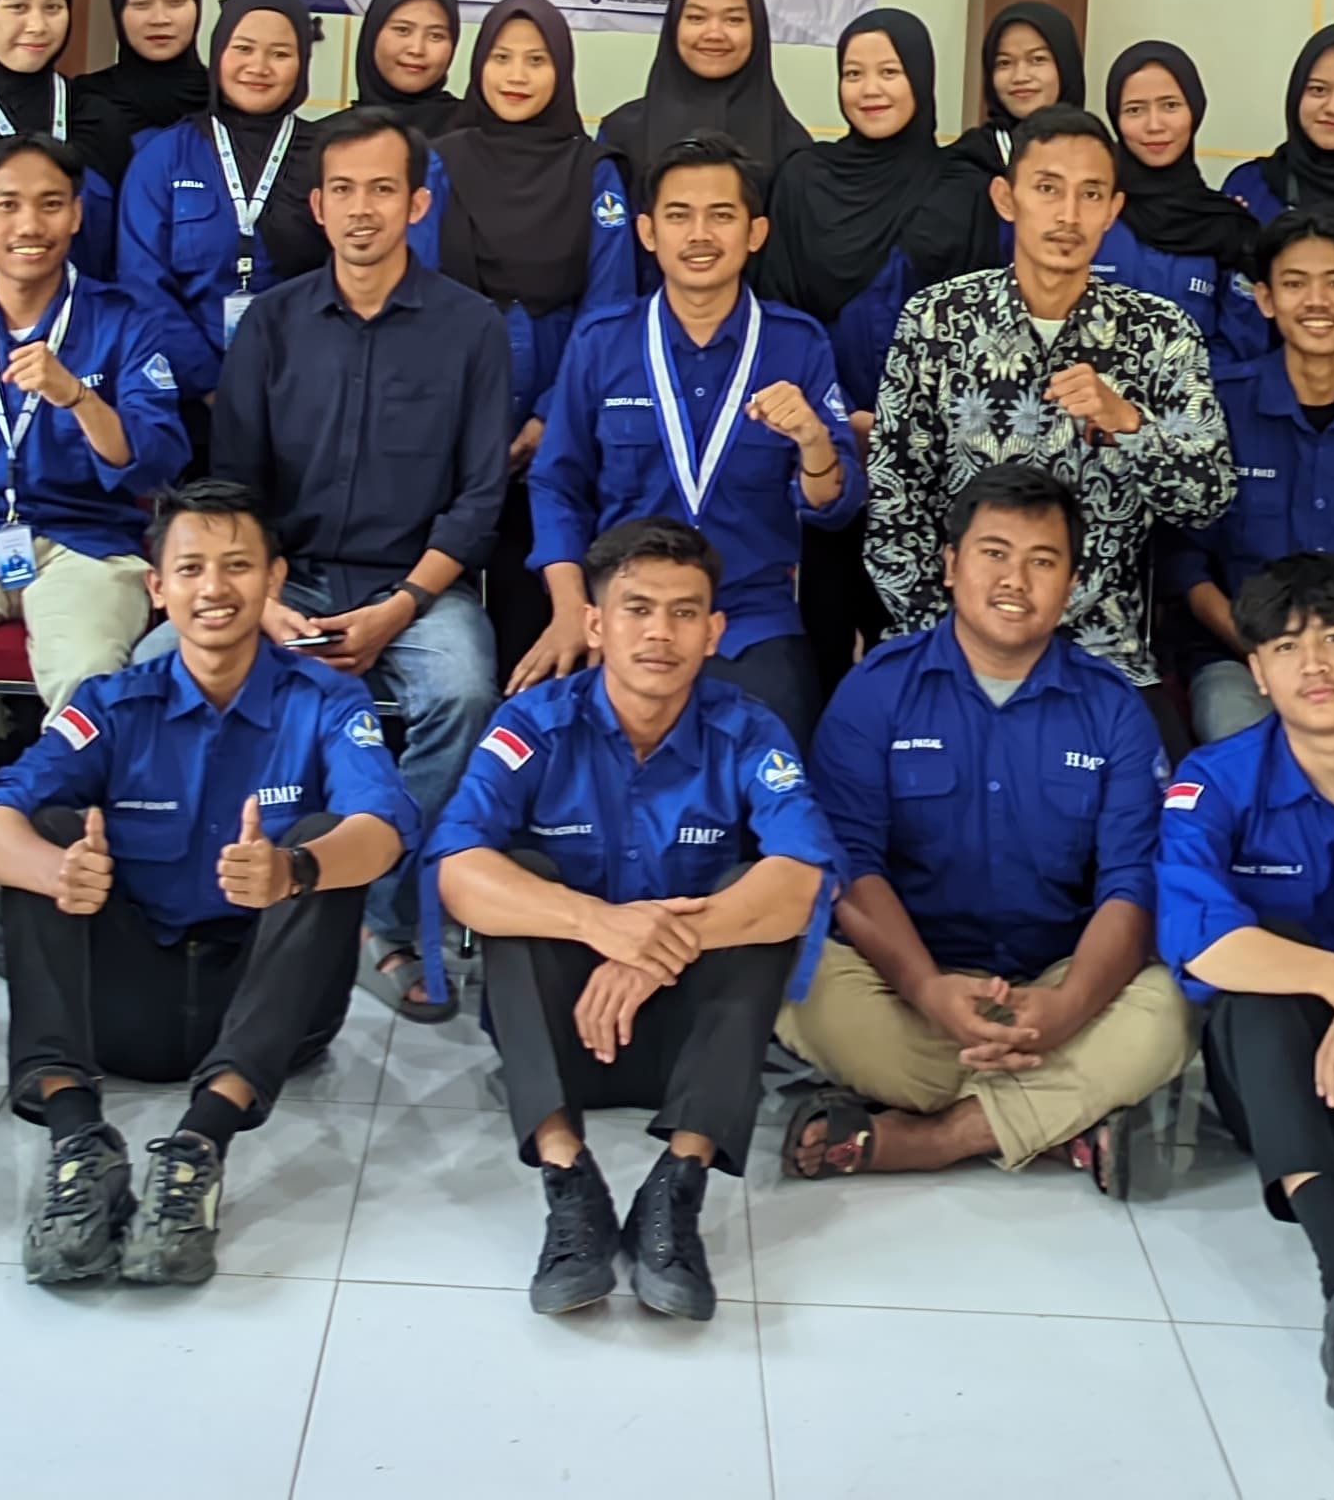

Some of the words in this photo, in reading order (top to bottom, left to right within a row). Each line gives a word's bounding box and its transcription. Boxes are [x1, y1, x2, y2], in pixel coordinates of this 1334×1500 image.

[1065, 752, 1105, 771] HMP
[258, 785, 303, 805] HMP
[678, 827, 725, 845] HMP
